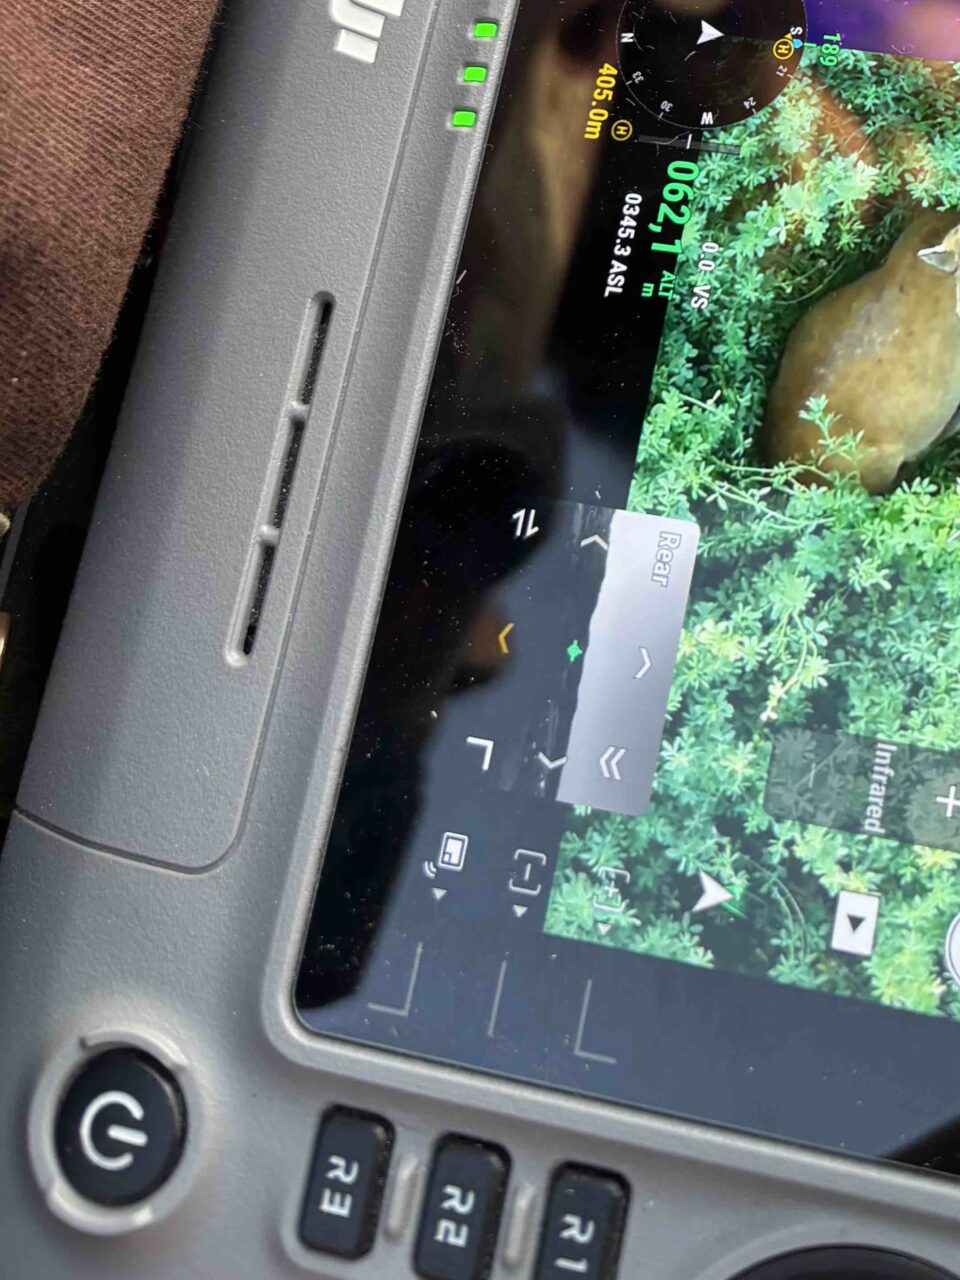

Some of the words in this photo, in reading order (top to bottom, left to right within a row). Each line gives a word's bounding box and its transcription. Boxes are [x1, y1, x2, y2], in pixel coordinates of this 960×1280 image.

[620, 32, 634, 43] N
[789, 26, 802, 36] S
[819, 32, 842, 68] 189
[632, 71, 644, 84] 33
[776, 65, 788, 77] 21
[584, 62, 618, 140] 405.0m
[660, 100, 674, 112] 30
[742, 96, 756, 110] 24
[700, 111, 714, 126] W
[648, 160, 700, 254] 062,1
[612, 192, 643, 257] 0345.3
[698, 242, 720, 271] 0.0
[603, 260, 630, 298] ASL
[640, 282, 655, 298] m
[658, 270, 676, 300] ALT
[690, 284, 712, 310] VS
[650, 530, 682, 588] Rear
[862, 742, 897, 834] Infrared
[319, 1155, 360, 1218] R3
[434, 1184, 475, 1248] R2
[554, 1214, 594, 1273] R1
